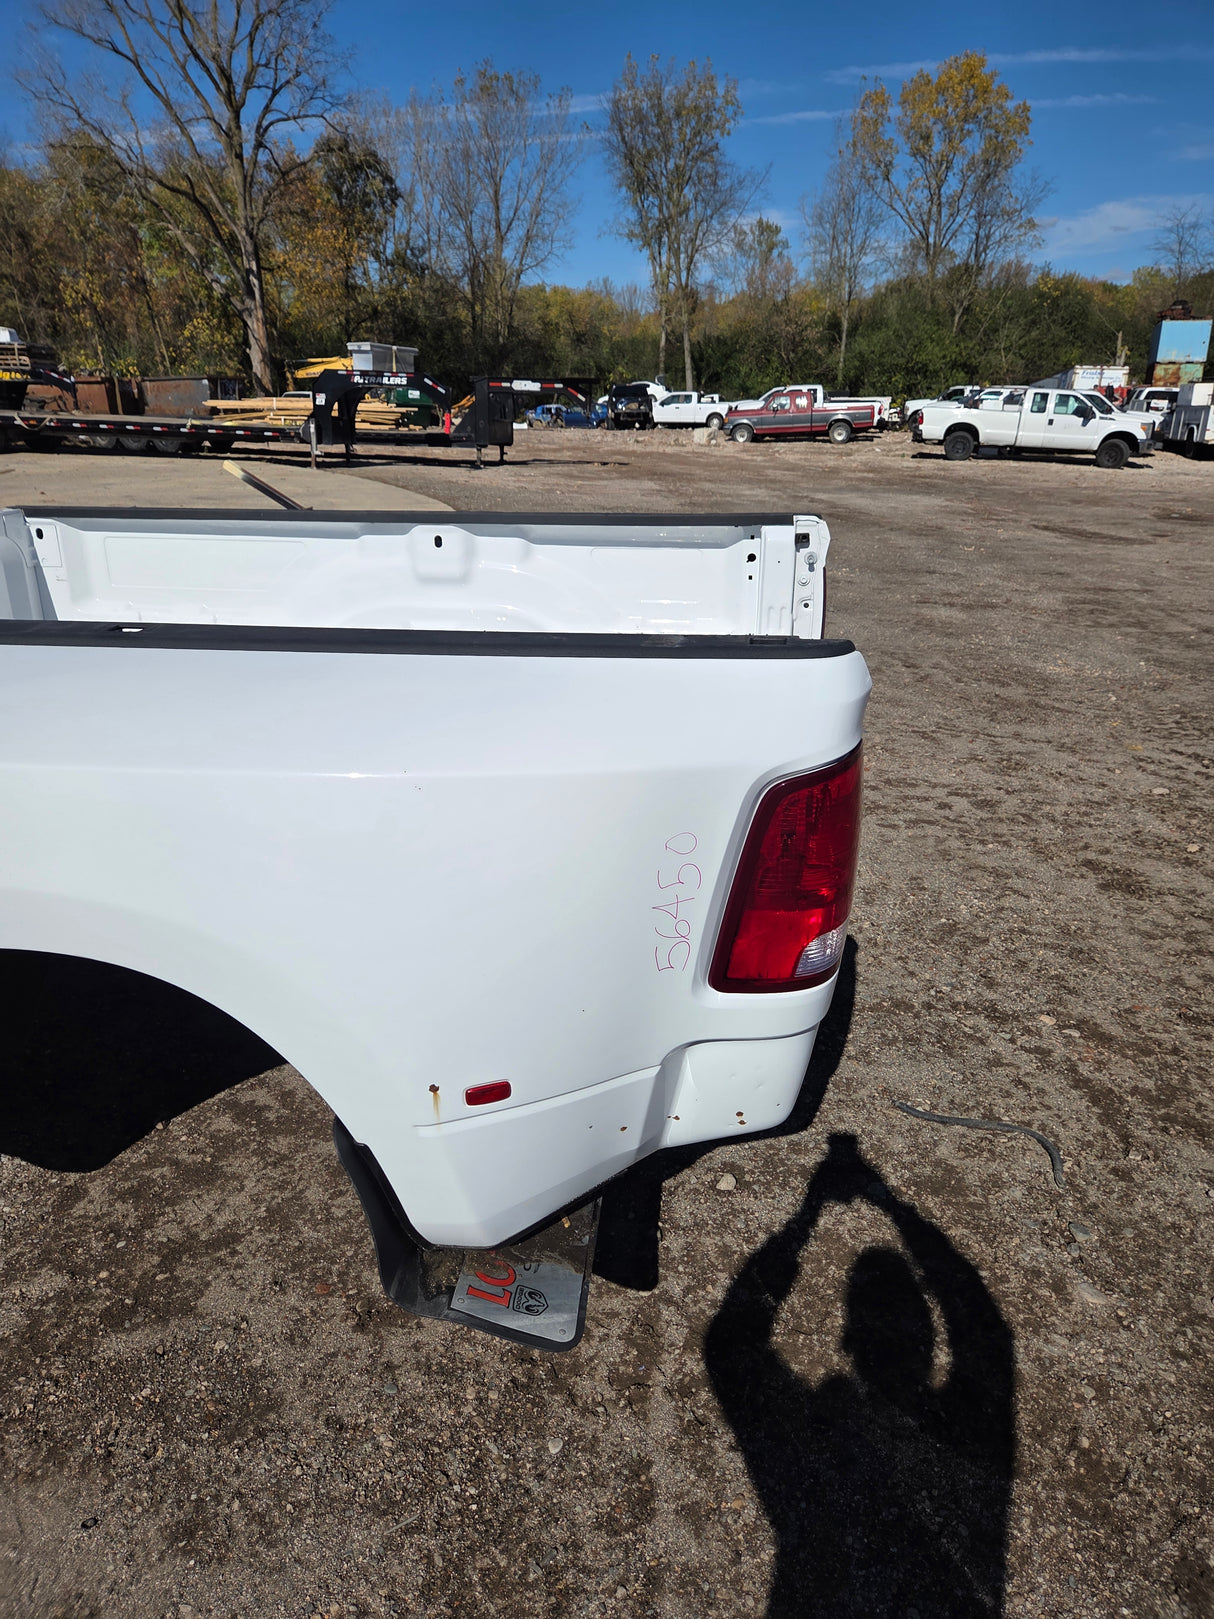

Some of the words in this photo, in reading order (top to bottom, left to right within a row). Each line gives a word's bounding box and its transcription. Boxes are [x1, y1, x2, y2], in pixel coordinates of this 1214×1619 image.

[364, 376, 408, 385] TRAILERS
[652, 832, 701, 971] 56450
[516, 1288, 525, 1310] DODGE
